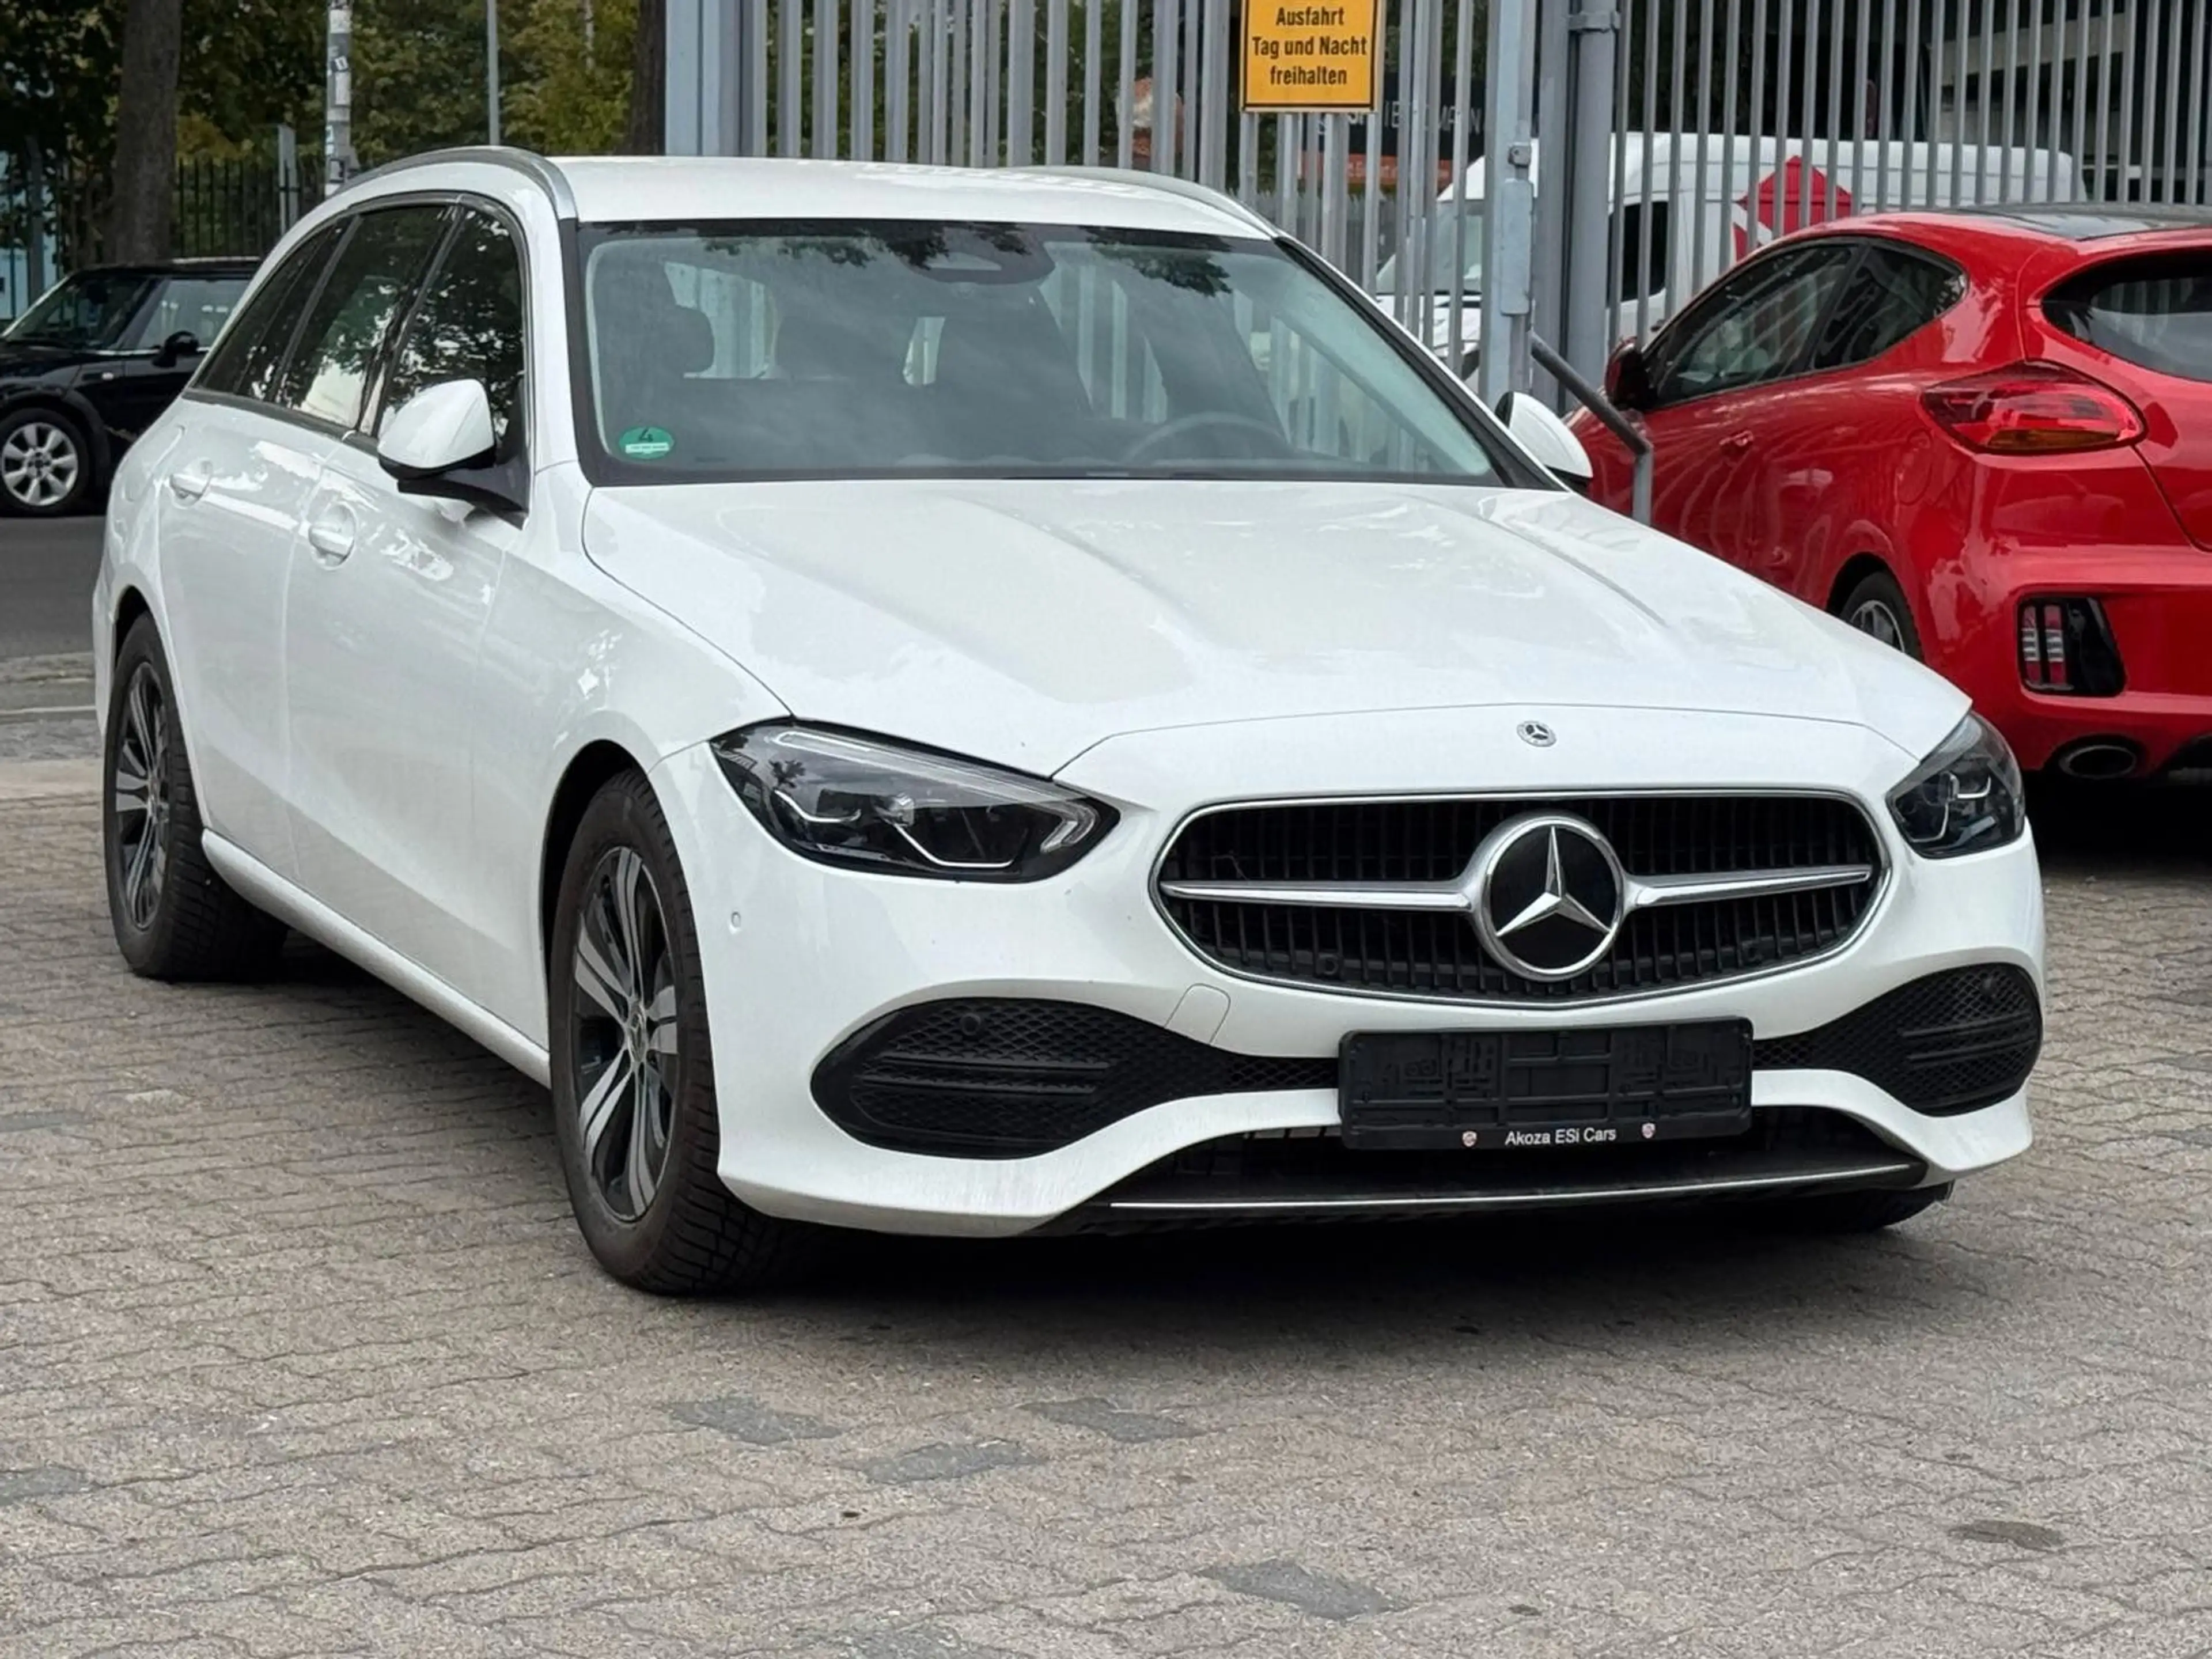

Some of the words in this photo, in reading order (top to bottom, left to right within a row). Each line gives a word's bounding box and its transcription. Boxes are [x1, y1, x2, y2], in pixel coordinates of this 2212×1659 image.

[1275, 6, 1344, 26] Ausfahrt
[1252, 36, 1279, 59] Tag
[1284, 36, 1314, 55] und
[1319, 36, 1367, 55] Nacht
[1270, 65, 1347, 85] freihalten
[638, 429, 654, 442] 4
[1505, 1130, 1551, 1146] Akoza
[1584, 1127, 1616, 1142] Cars
